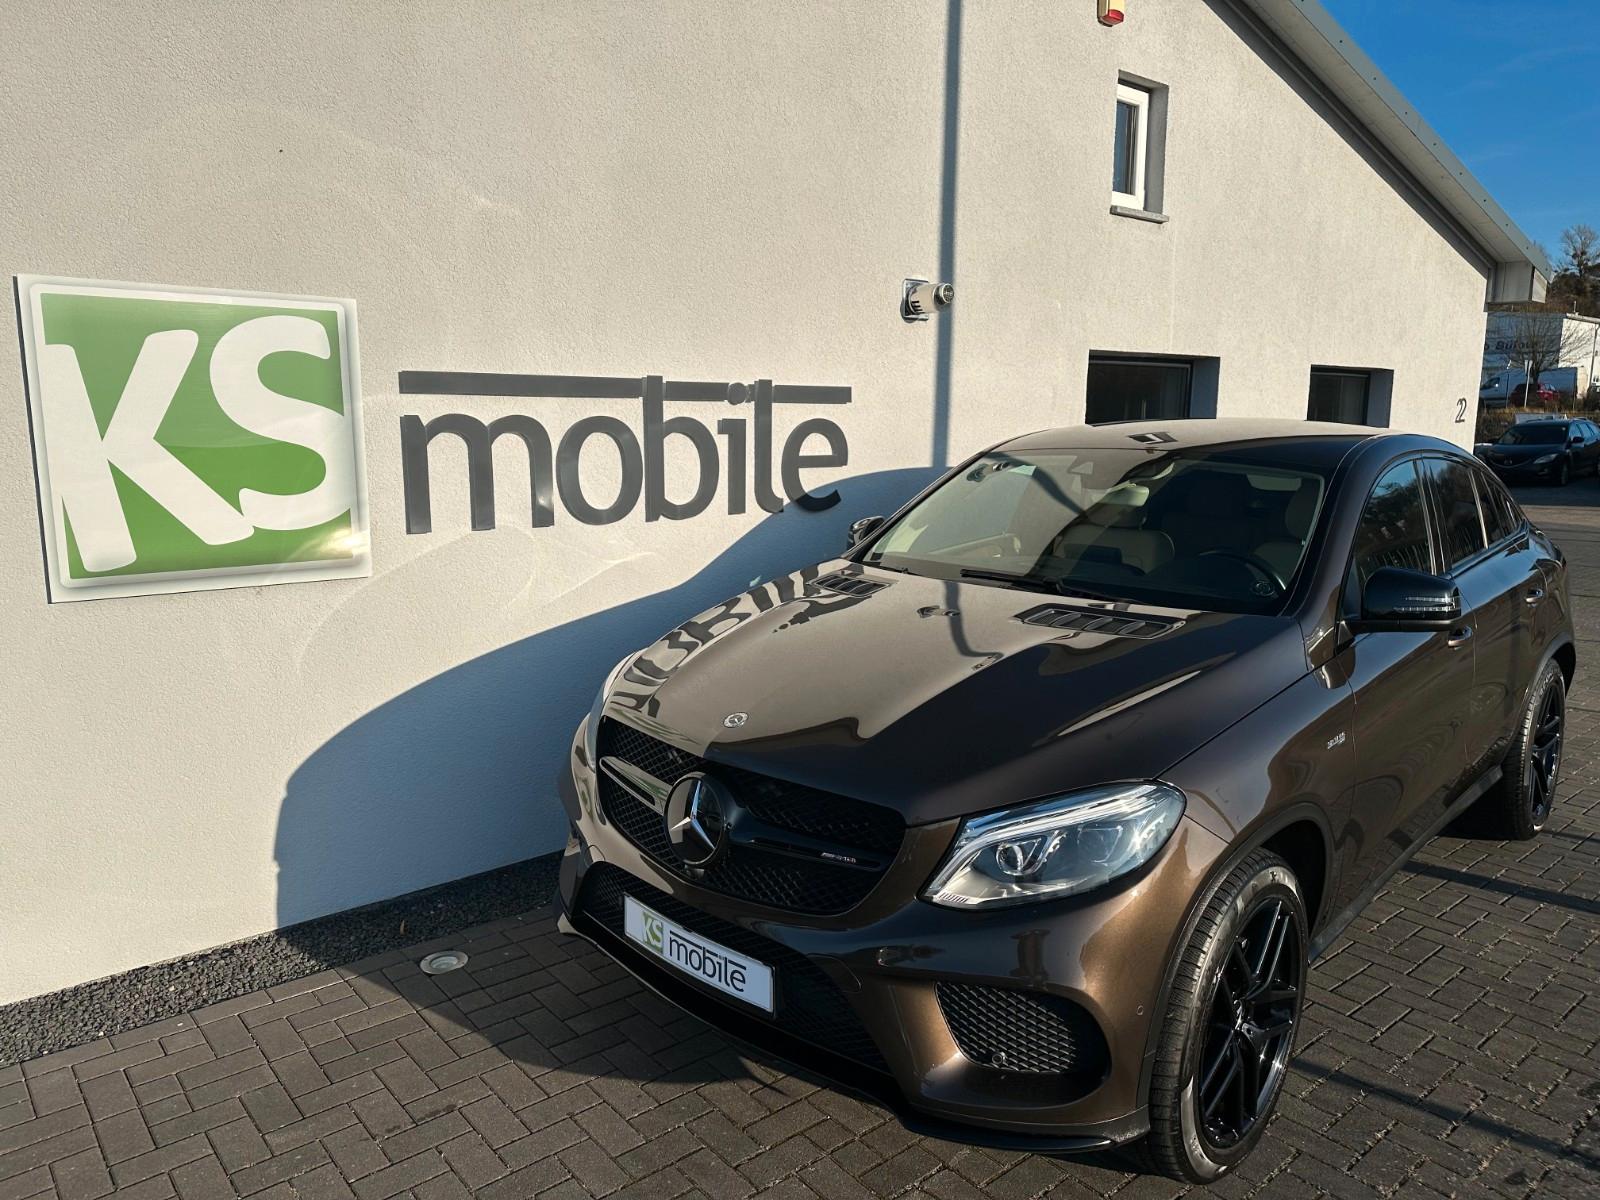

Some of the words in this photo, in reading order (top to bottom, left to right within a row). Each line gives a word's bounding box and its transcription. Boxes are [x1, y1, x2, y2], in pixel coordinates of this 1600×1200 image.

[44, 315, 352, 572] KS
[399, 373, 850, 534] mobile
[642, 911, 664, 951] KS
[669, 931, 747, 992] mobile
